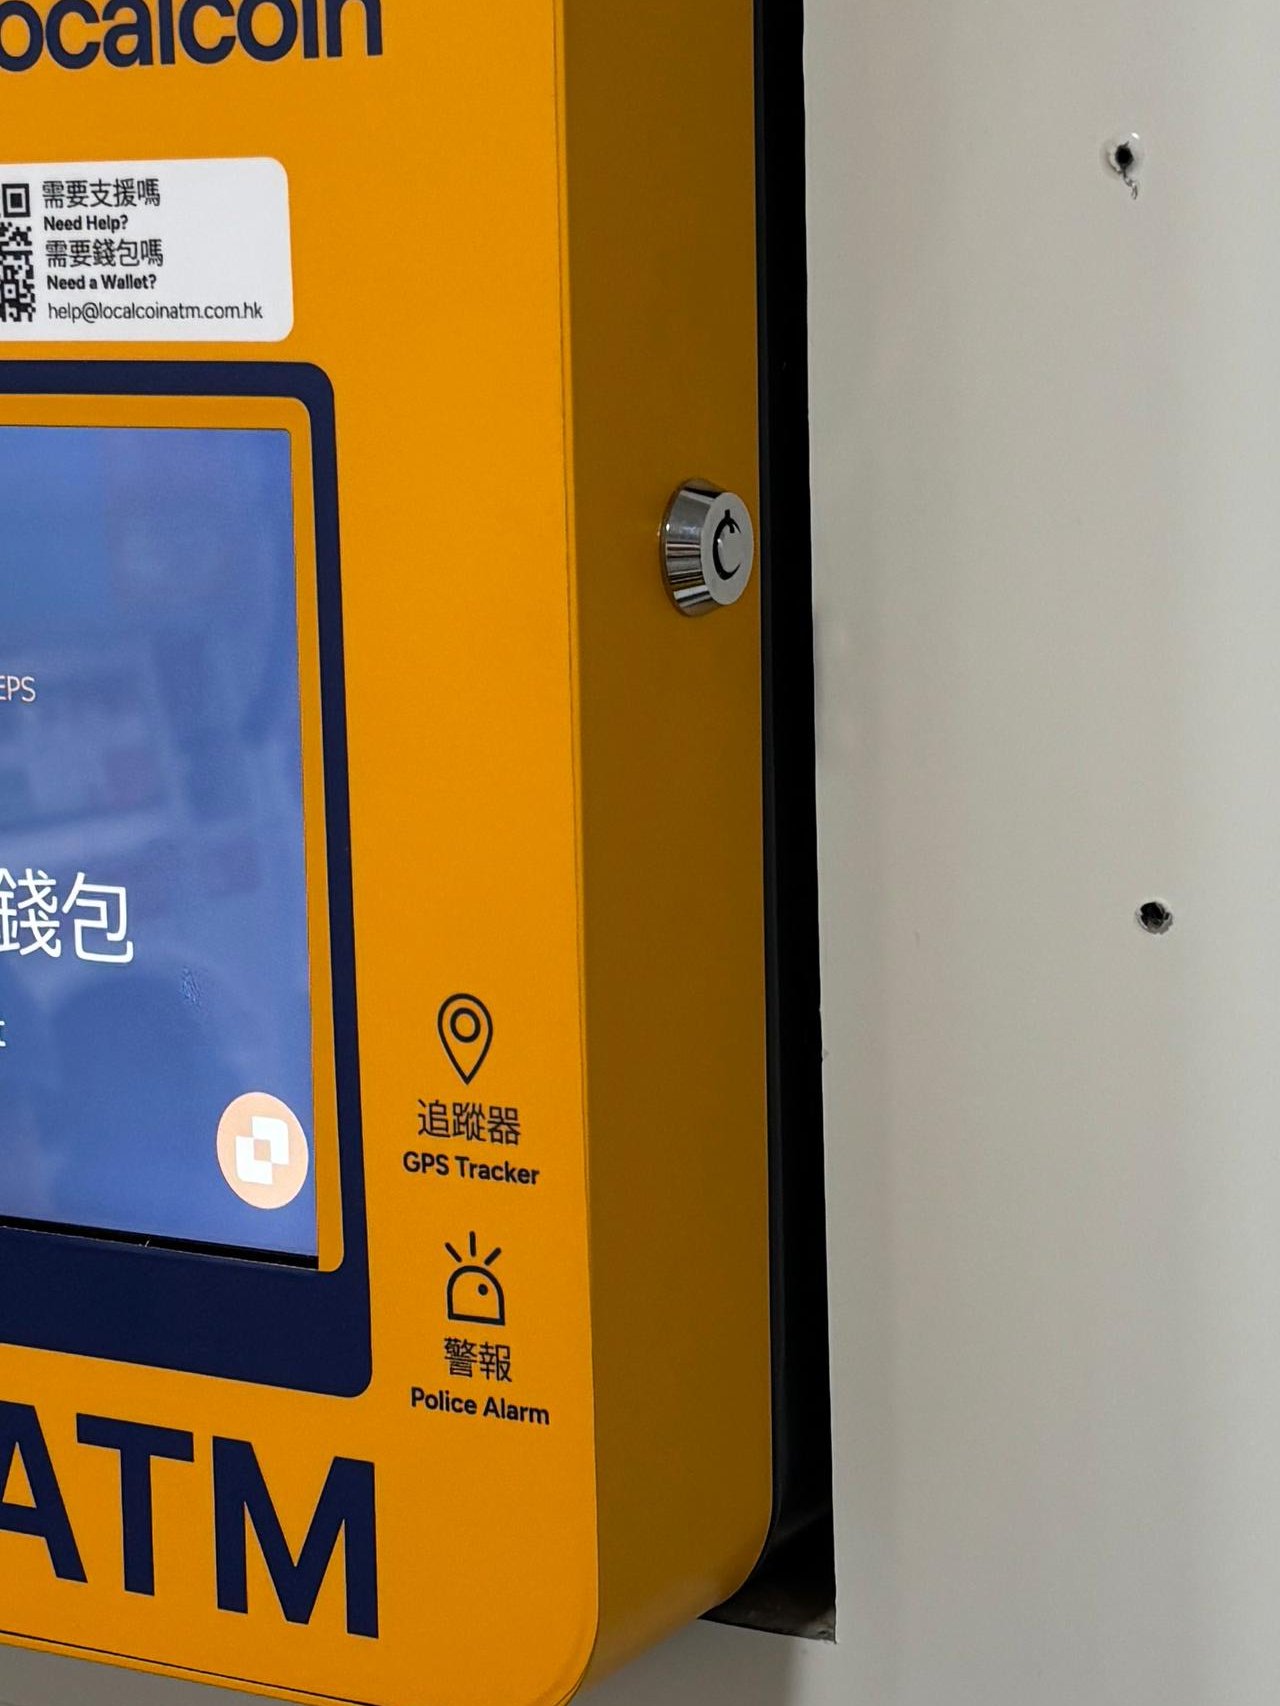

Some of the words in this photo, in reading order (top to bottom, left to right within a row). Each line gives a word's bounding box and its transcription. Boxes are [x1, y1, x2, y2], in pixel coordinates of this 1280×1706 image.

[42, 177, 160, 209] 需要支援嗎
[44, 216, 83, 230] Need
[86, 215, 129, 233] Help?
[45, 238, 164, 268] 需要錢包嗎
[47, 275, 86, 289] Need
[89, 279, 98, 289] a
[101, 274, 157, 289] Wallet?
[48, 302, 263, 323] help@localcoinatm.com.hk
[417, 1098, 521, 1146] 追蹤器
[403, 1151, 450, 1177] GPS
[454, 1155, 540, 1186] Tracker
[443, 1336, 513, 1383] 警報
[410, 1385, 478, 1417] Police
[482, 1395, 550, 1426] Alarm
